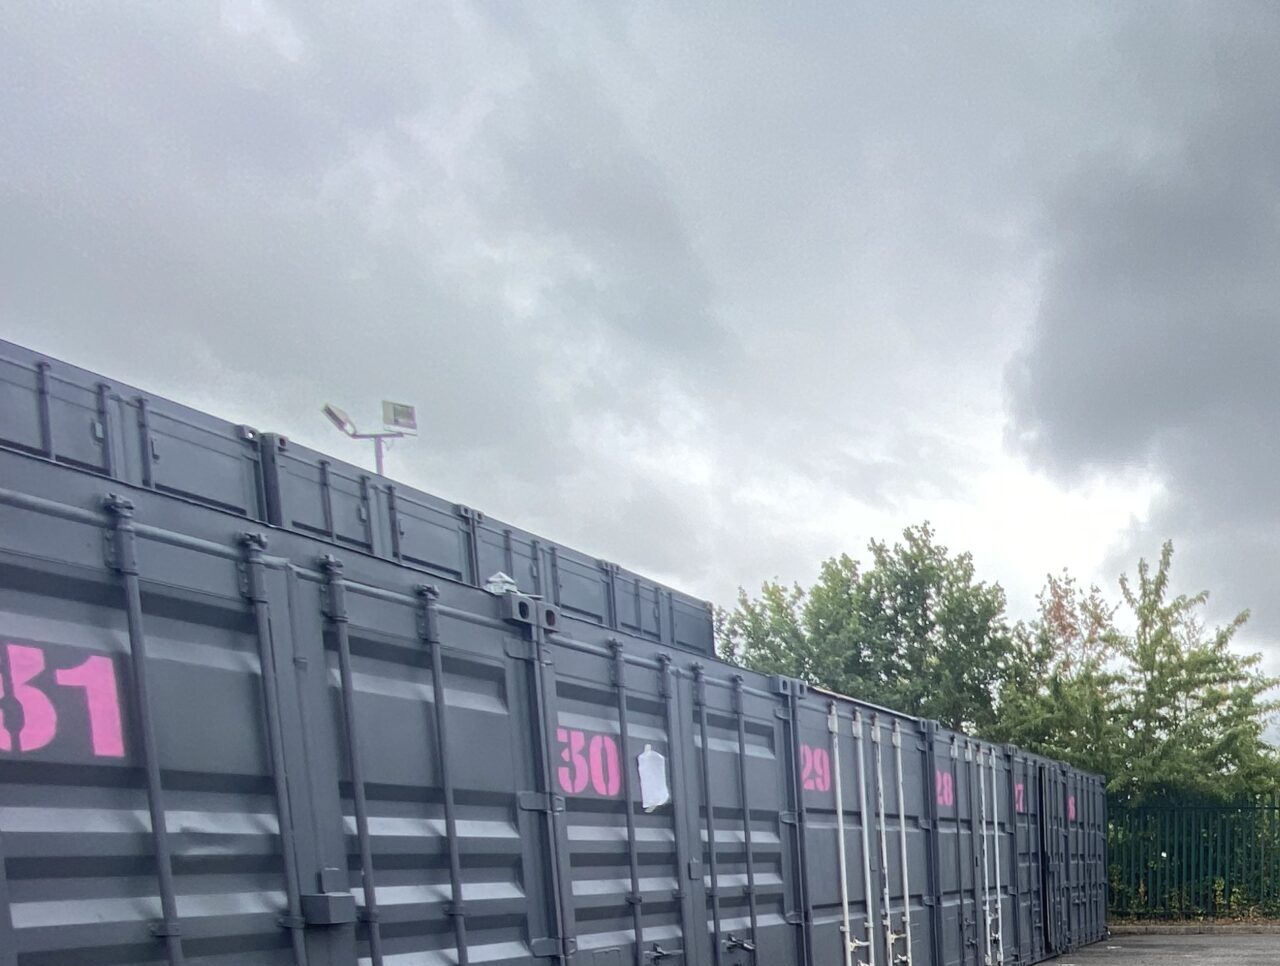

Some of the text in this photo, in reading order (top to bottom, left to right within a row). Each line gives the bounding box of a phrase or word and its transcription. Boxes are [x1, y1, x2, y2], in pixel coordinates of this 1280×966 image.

[0, 644, 124, 757] 31
[557, 728, 620, 796] 30
[801, 744, 830, 791] 29
